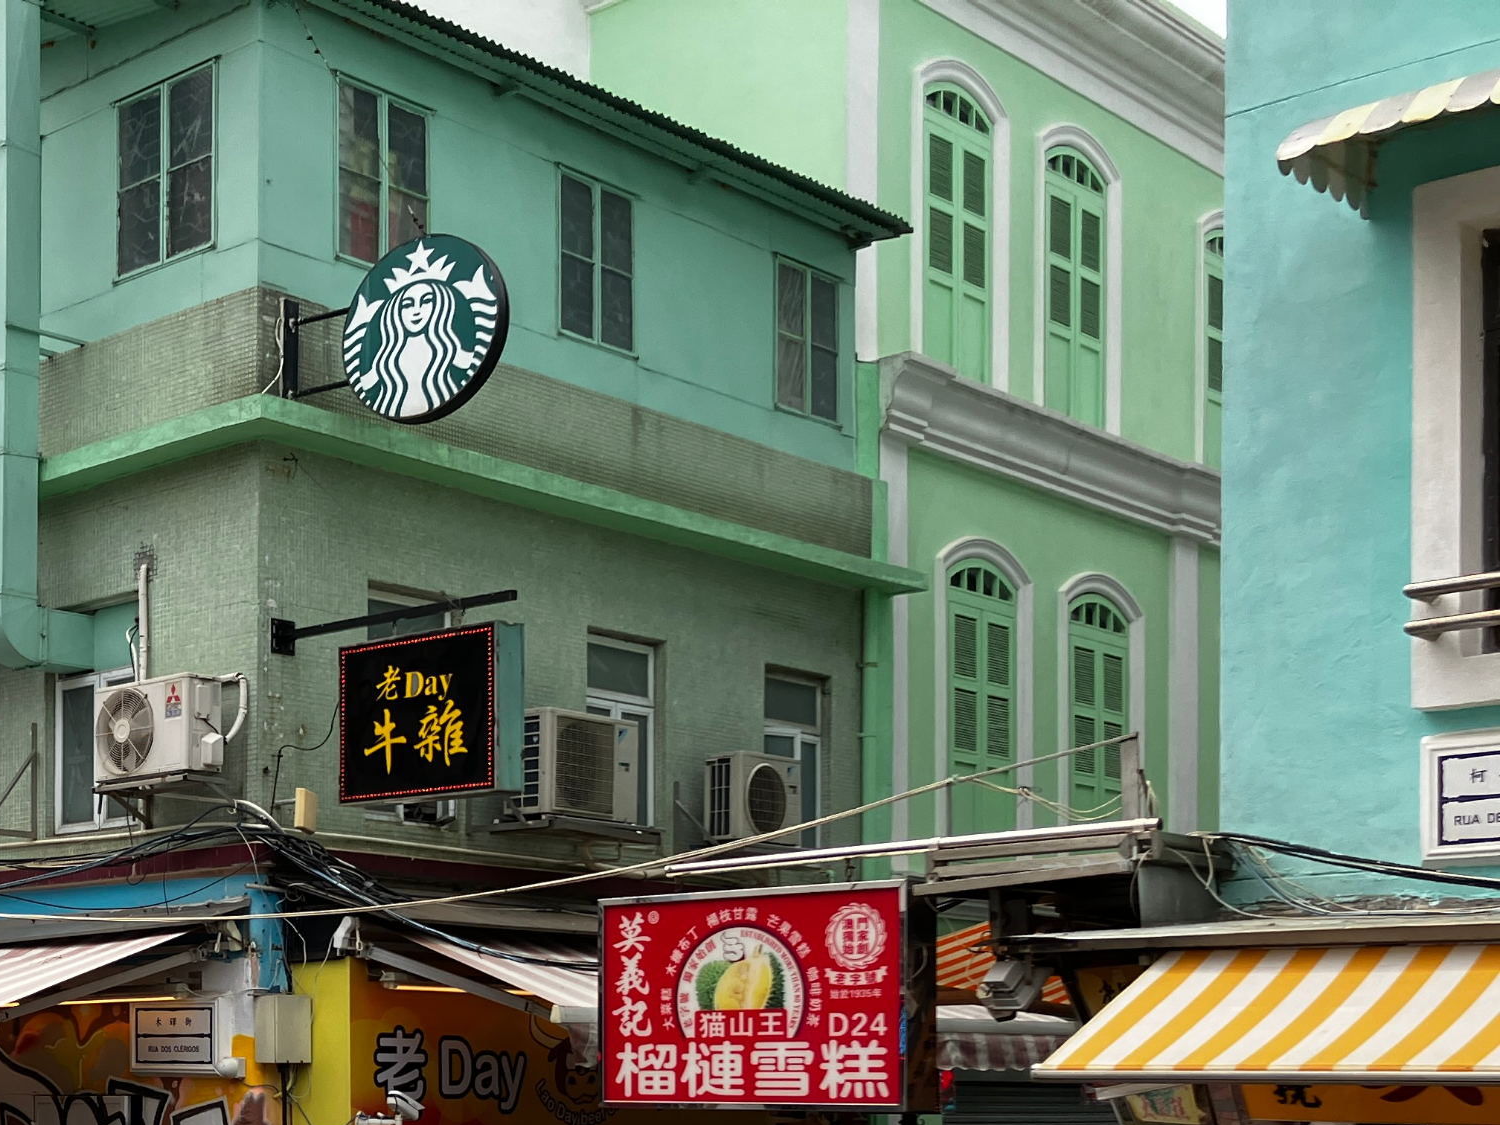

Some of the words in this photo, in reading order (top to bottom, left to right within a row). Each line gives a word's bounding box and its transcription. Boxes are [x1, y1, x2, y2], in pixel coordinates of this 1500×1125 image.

[364, 699, 468, 775] 牛雜
[1454, 814, 1481, 826] RUA
[612, 912, 652, 1037] 莫義記
[699, 1012, 784, 1038] 猫山王
[828, 1012, 888, 1038] D24
[148, 1045, 159, 1053] RUA
[161, 1045, 172, 1053] DOS
[174, 1044, 200, 1053] CLÉRIGOS
[375, 1027, 427, 1102] 老
[439, 1036, 526, 1113] Day
[615, 1040, 890, 1099] 榴槤雪糕
[536, 1078, 556, 1112] Lao
